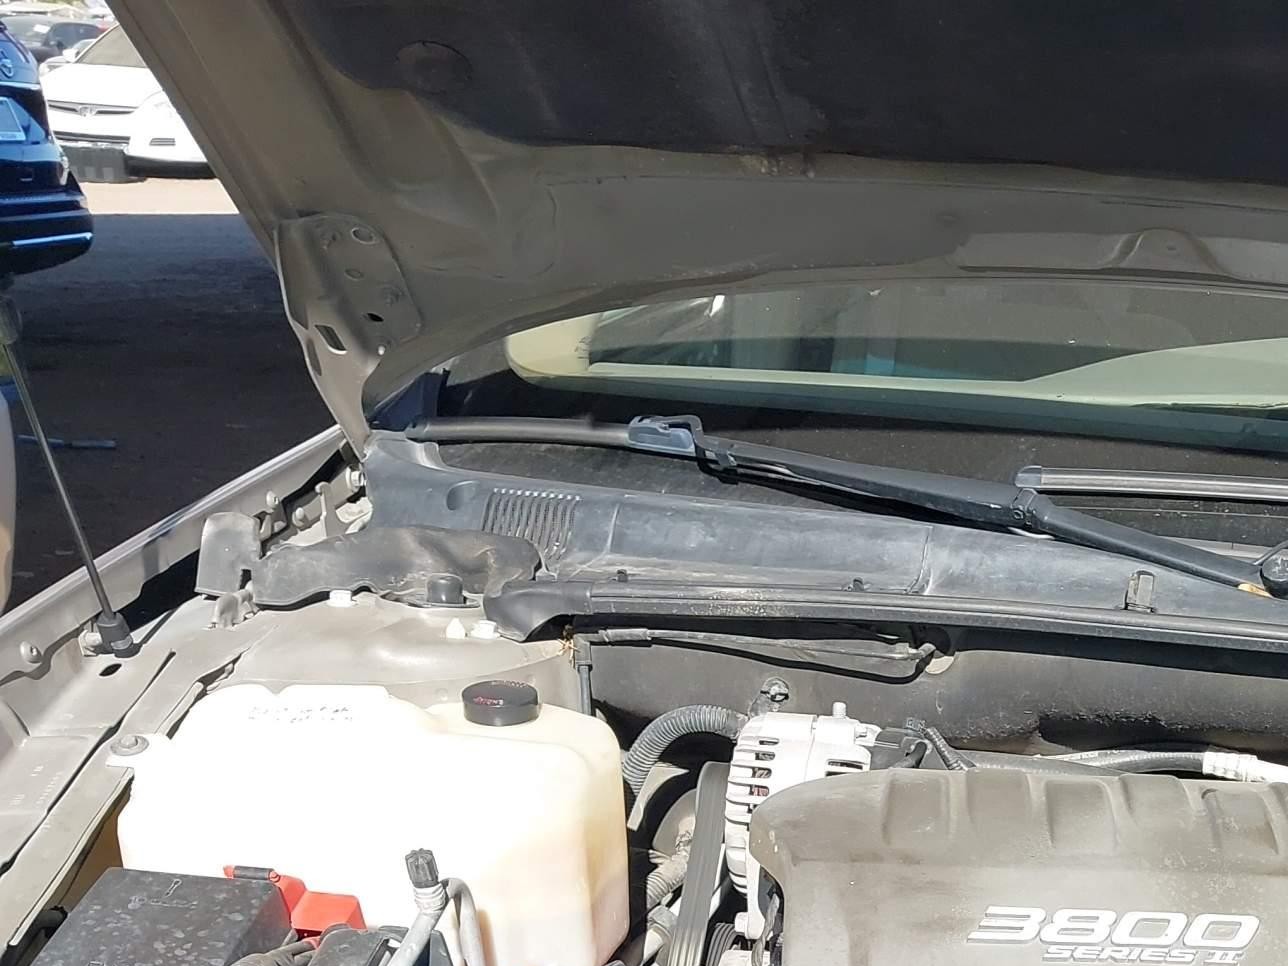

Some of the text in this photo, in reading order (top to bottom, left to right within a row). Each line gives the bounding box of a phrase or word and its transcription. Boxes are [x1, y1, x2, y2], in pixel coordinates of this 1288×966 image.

[967, 905, 1261, 949] 3800
[1042, 945, 1245, 966] SERIES II
